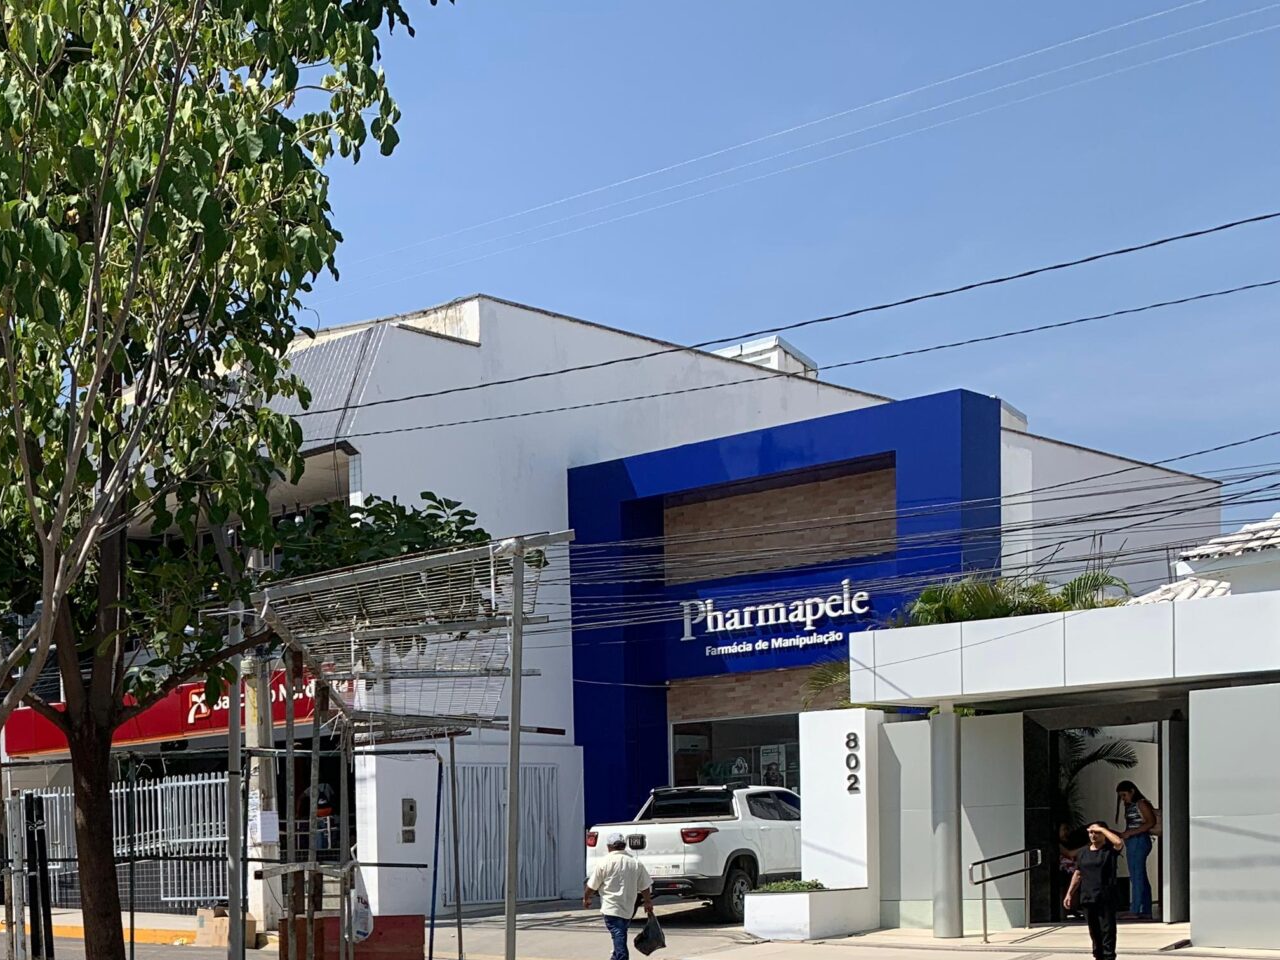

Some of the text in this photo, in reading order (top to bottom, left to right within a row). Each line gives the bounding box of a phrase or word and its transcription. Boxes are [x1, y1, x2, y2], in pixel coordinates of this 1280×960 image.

[679, 578, 870, 642] Pharmapele
[705, 631, 844, 656] Farmácia de Manipulação
[845, 732, 861, 792] 802
